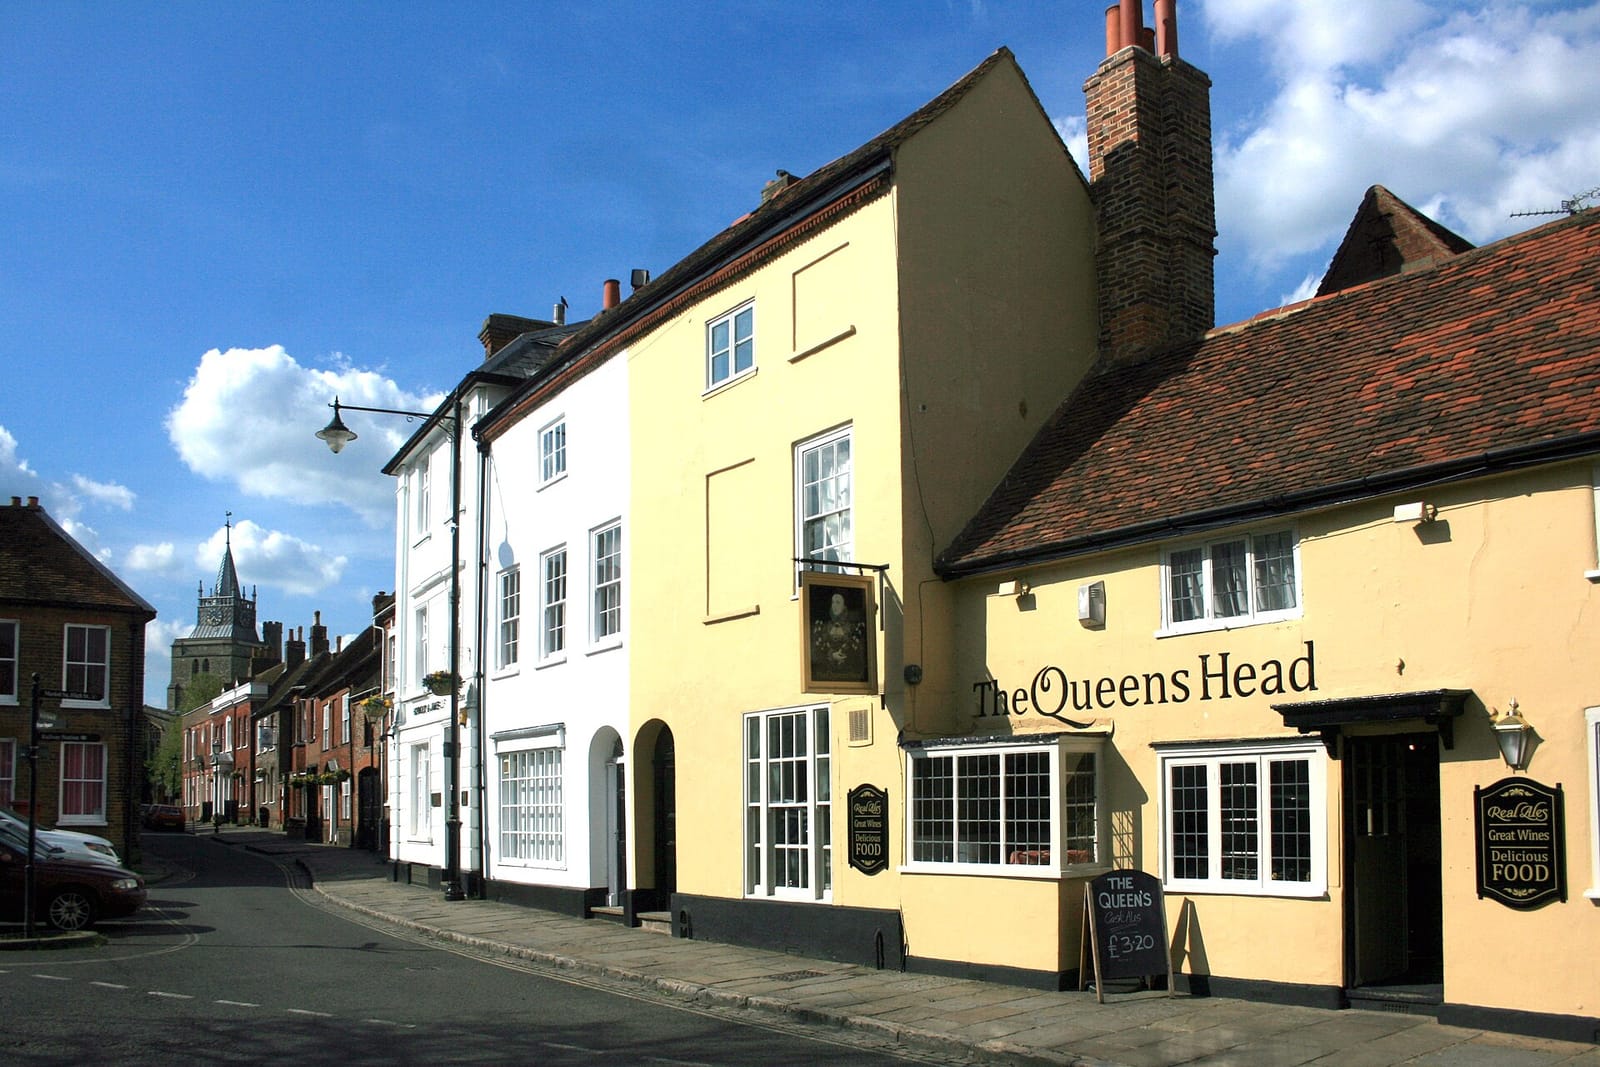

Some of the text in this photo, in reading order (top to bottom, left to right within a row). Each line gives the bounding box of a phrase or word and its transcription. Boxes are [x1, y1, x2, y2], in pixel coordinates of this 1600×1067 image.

[973, 640, 1319, 729] The Queens Head
[854, 801, 869, 814] Real
[1487, 802, 1548, 821] Real Ales
[854, 820, 881, 828] Great Wines
[855, 834, 881, 842] Delicious
[1488, 829, 1550, 841] Great Wines
[855, 843, 881, 855] FOOD
[1491, 850, 1549, 862] Delicious
[1492, 863, 1550, 882] FOOD
[1107, 877, 1134, 890] THE
